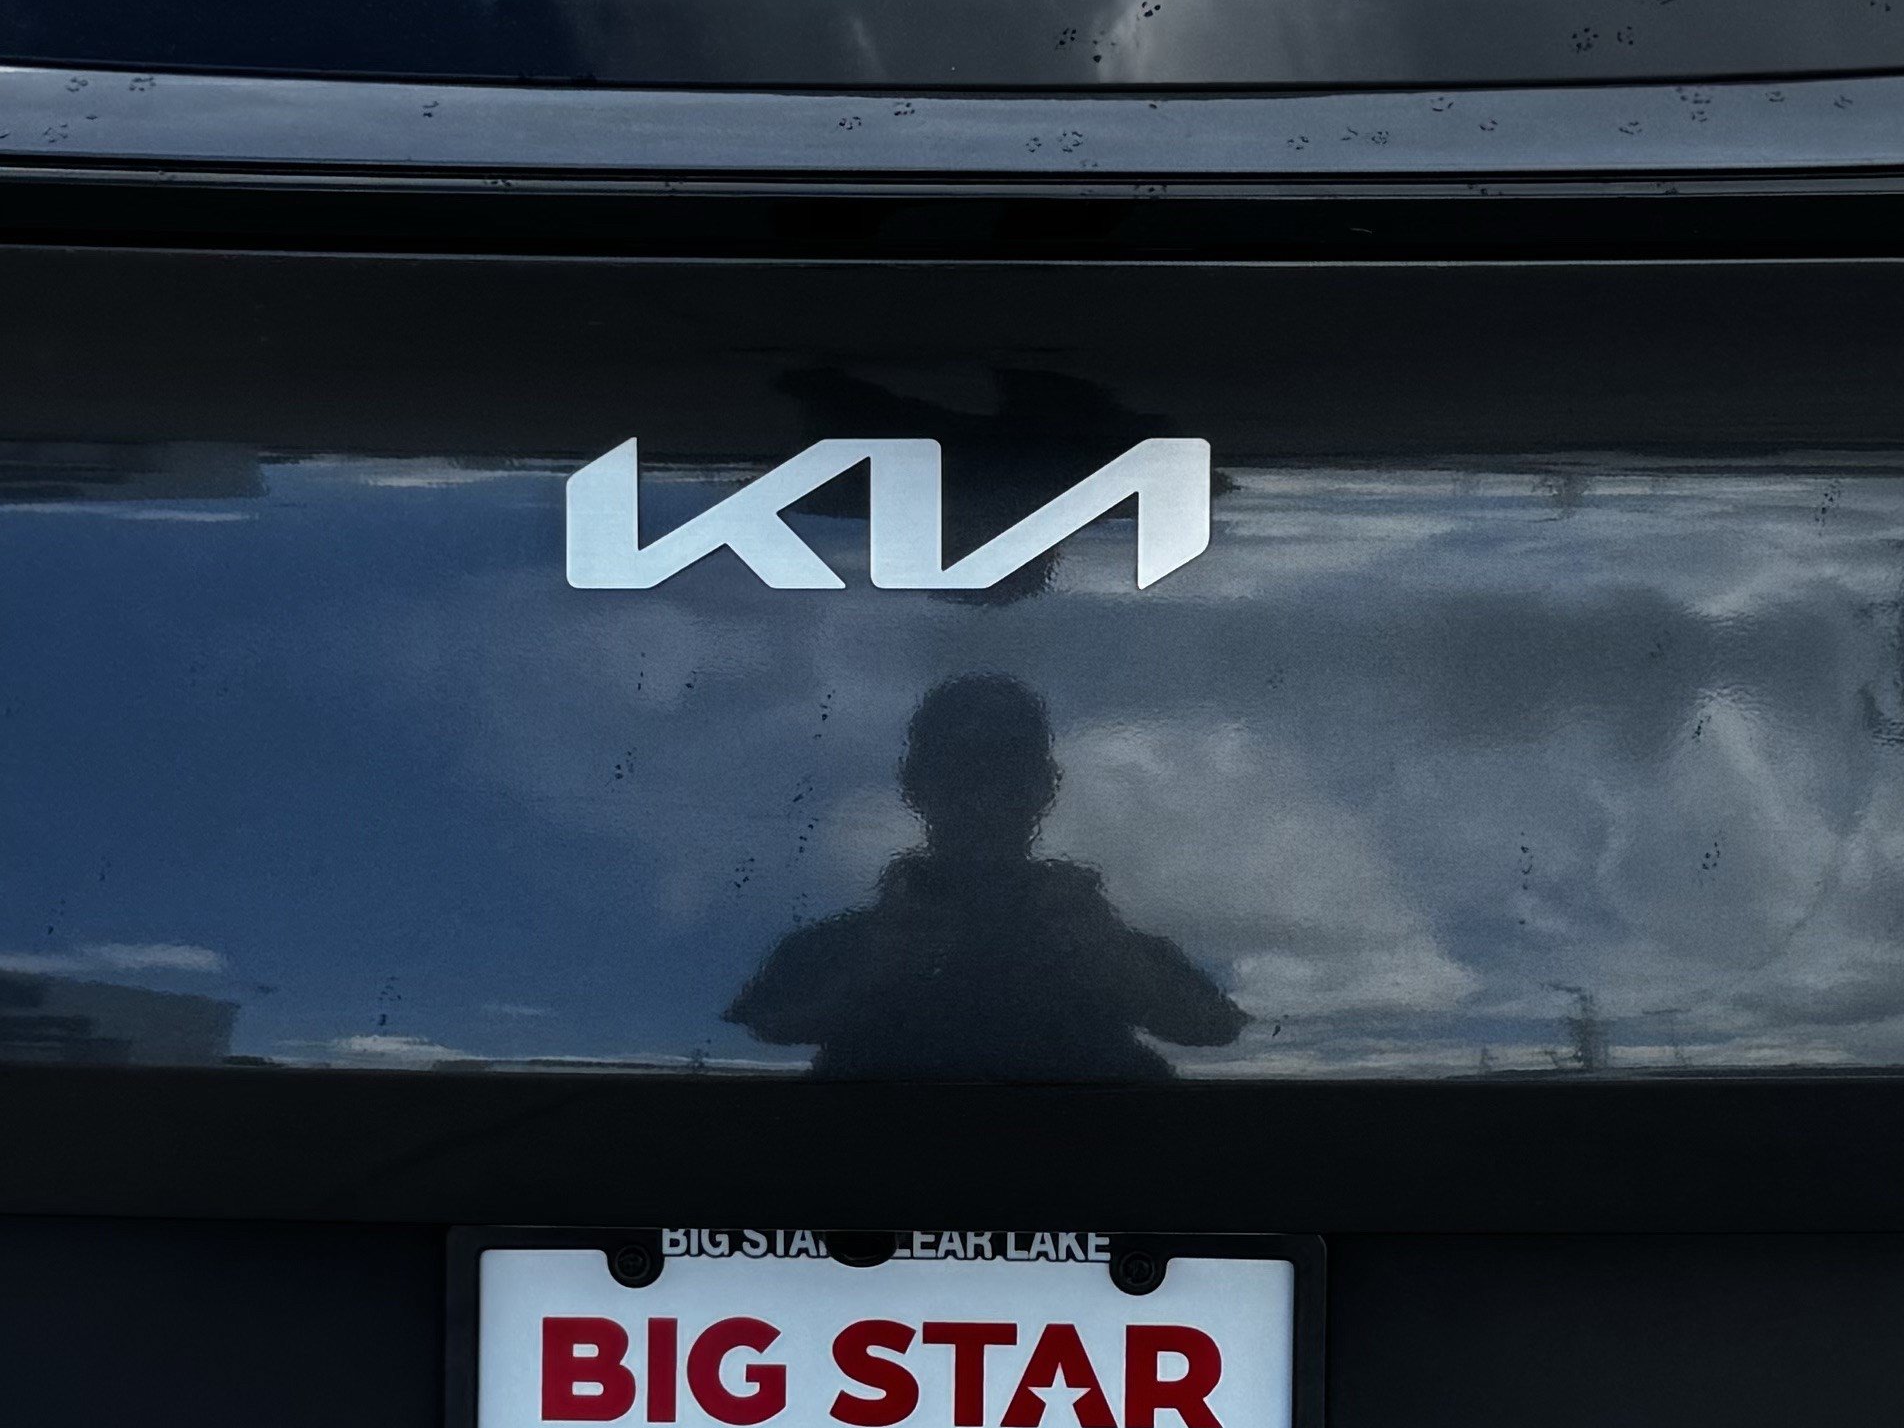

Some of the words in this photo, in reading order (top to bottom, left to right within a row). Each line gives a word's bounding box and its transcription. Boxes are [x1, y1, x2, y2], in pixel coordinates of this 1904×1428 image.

[566, 436, 1211, 590] KIA
[662, 1228, 729, 1256] BIG
[1006, 1231, 1111, 1261] LAKE
[541, 1316, 787, 1426] BIG
